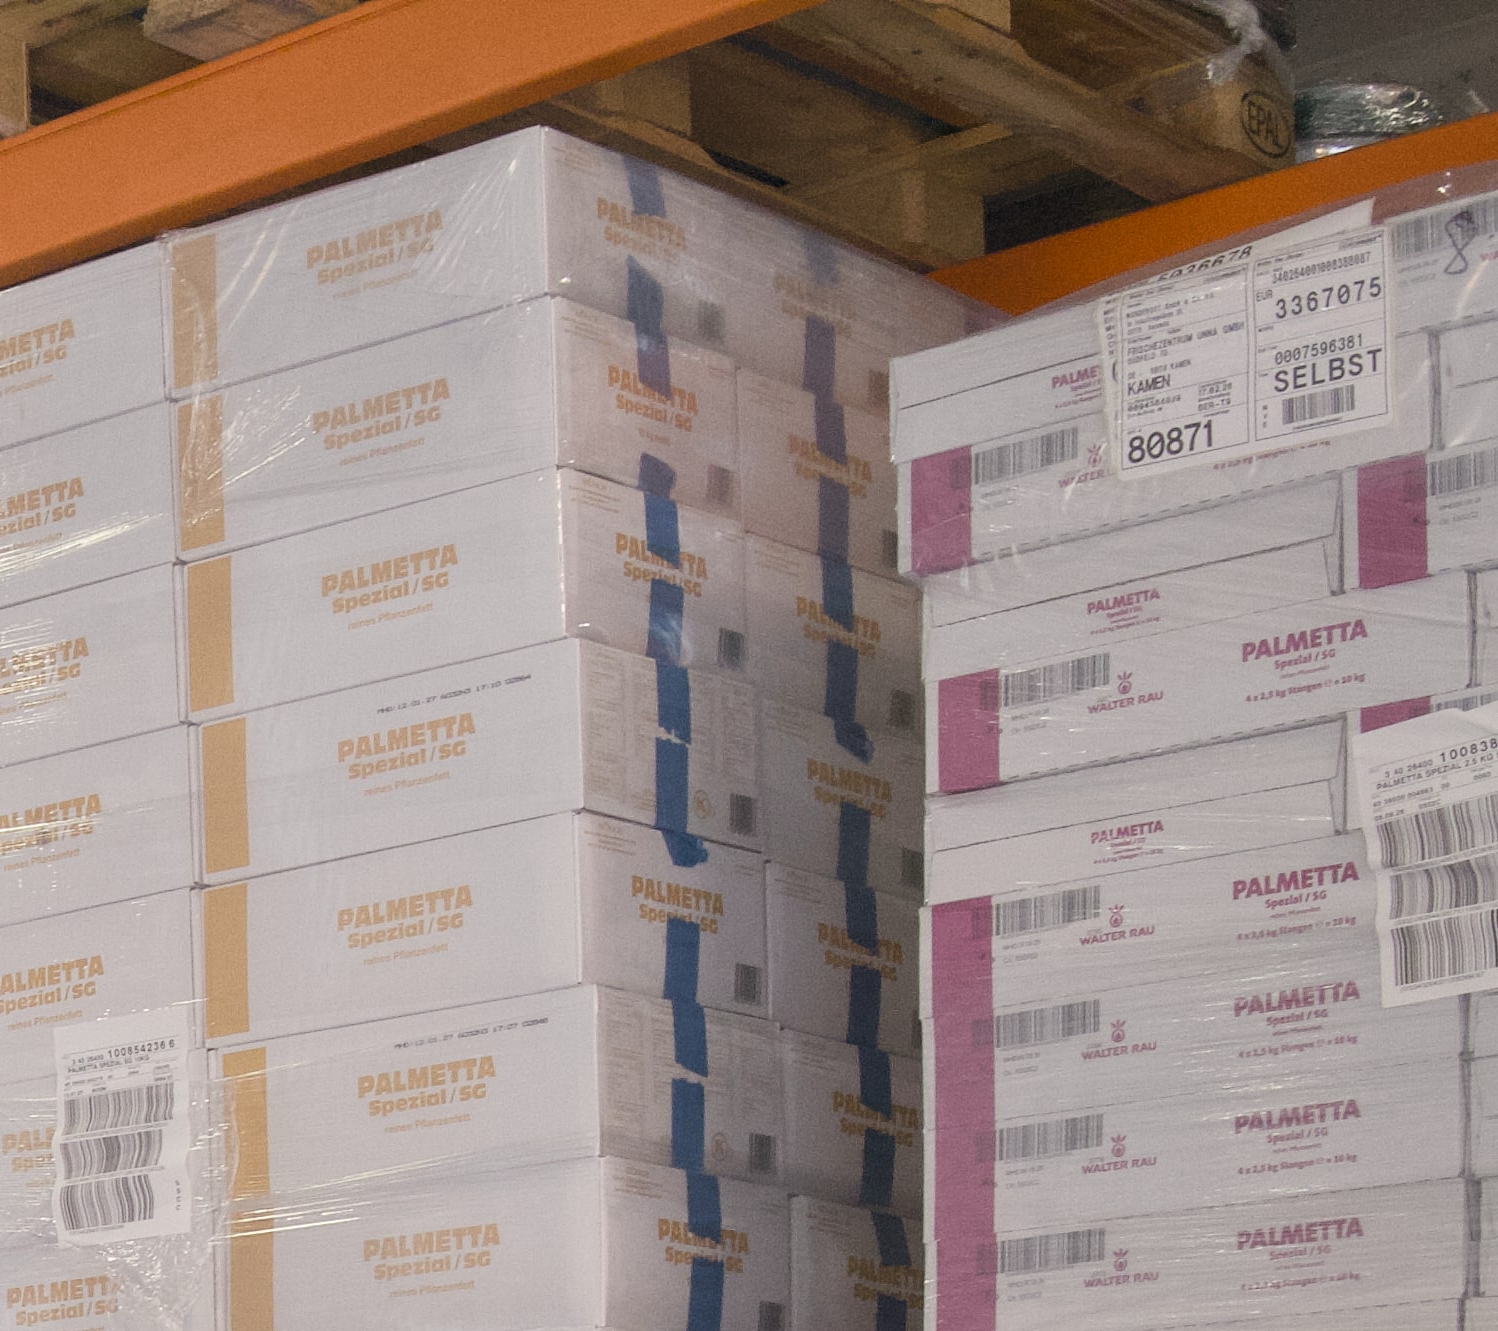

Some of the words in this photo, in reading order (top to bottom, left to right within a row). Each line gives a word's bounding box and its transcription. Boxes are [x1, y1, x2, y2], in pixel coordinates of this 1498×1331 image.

[1246, 100, 1288, 148] EPAL
[306, 208, 443, 271] PALMETTA
[1275, 276, 1382, 319] 3367075
[1275, 333, 1363, 365] 0007596381
[1127, 375, 1171, 396] KAMEN
[1274, 349, 1382, 392] SELBST
[312, 379, 451, 434] PALMETTA
[1127, 419, 1213, 464] 80871
[321, 543, 459, 598] PALMETTA
[331, 577, 410, 614] Spezial
[422, 571, 449, 594] SG
[1241, 618, 1368, 663] PALMETTA
[1087, 697, 1135, 714] WALTER
[1138, 691, 1164, 706] RAU
[337, 713, 475, 763] PALMETTA
[348, 746, 426, 780] Spezial
[438, 739, 467, 760] SG
[1377, 772, 1423, 790] PALMETTA
[631, 875, 723, 917] PALMETTA
[1232, 862, 1360, 899] PALMETTA
[337, 885, 474, 932] PALMETTA
[347, 918, 424, 949] Spezial
[437, 912, 464, 933] SG
[1079, 930, 1126, 946] WALTER
[1129, 926, 1155, 939] RAU
[1232, 981, 1361, 1017] PALMETTA
[1081, 1046, 1129, 1062] WALTER
[1132, 1041, 1157, 1055] RAU
[357, 1056, 496, 1099] PALMETTA
[1233, 1099, 1361, 1134] PALMETTA
[1081, 1160, 1129, 1175] WALTER
[1132, 1156, 1157, 1169] RAU
[363, 1224, 500, 1261] PALMETTA
[1236, 1217, 1364, 1250] PALMETTA
[1083, 1275, 1131, 1289] WALTER
[1134, 1271, 1159, 1282] RAU
